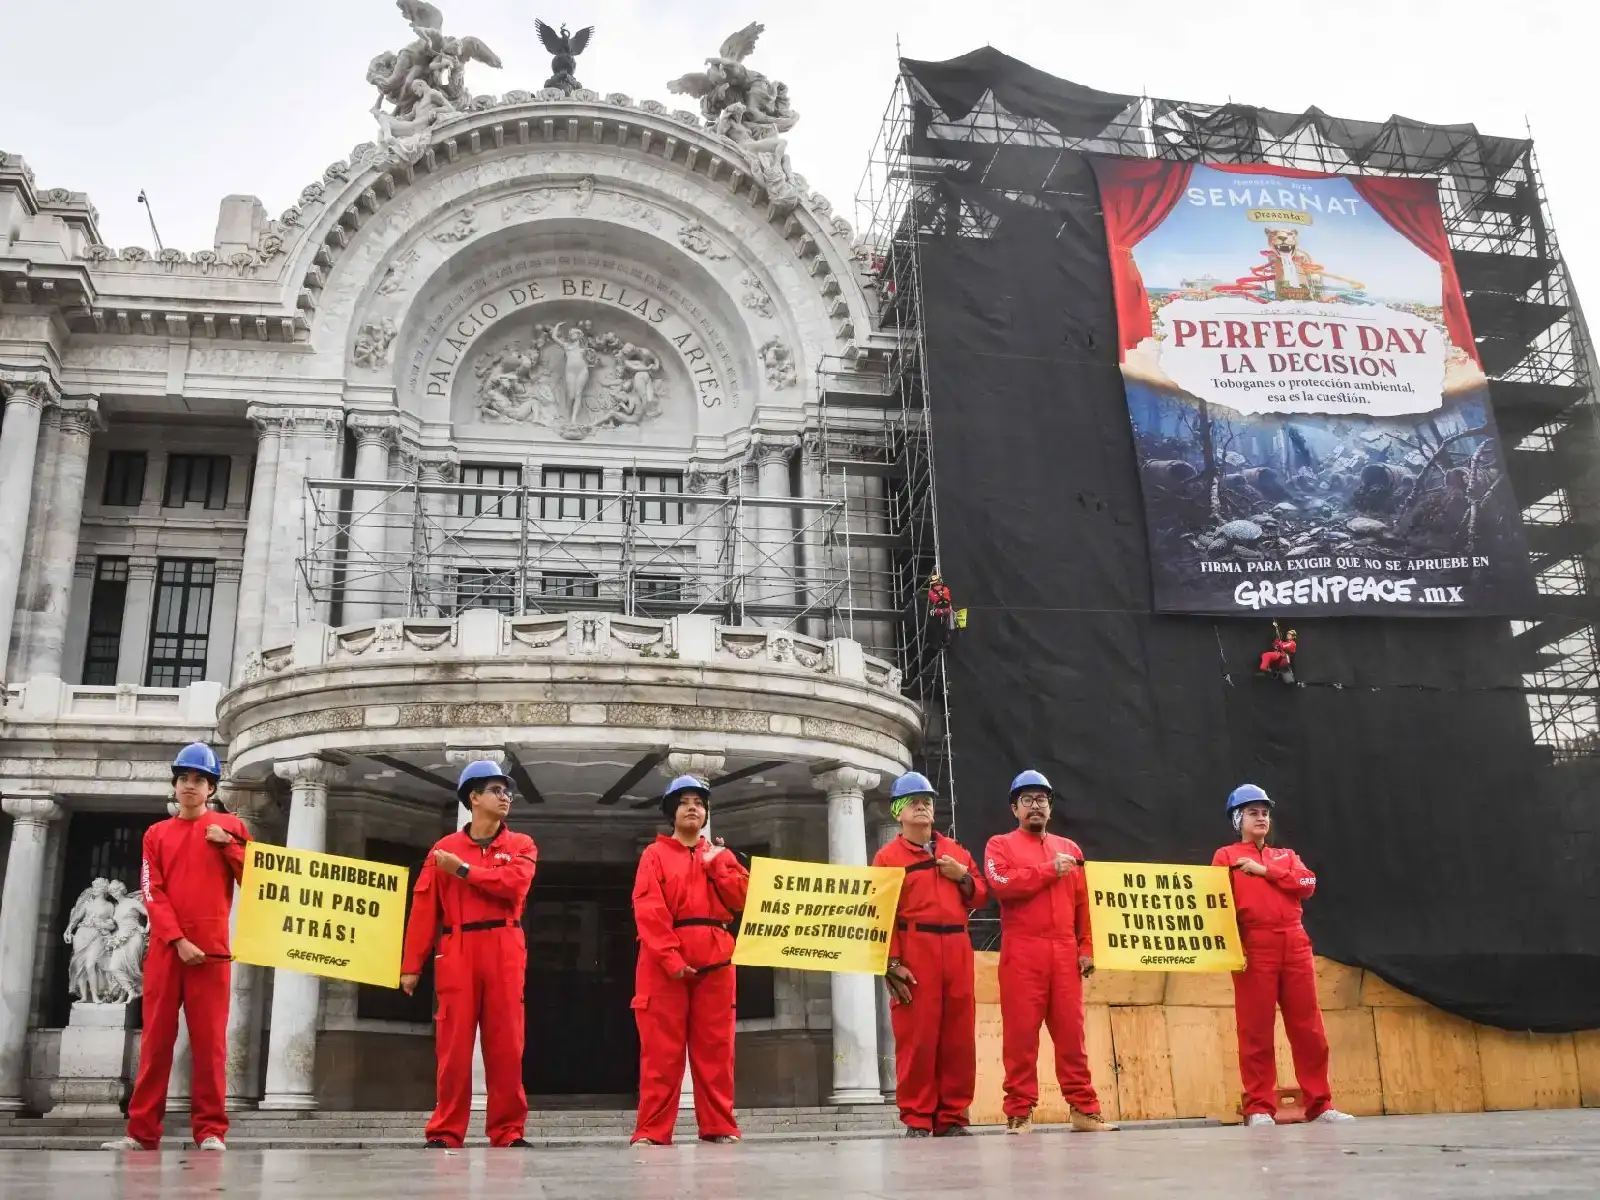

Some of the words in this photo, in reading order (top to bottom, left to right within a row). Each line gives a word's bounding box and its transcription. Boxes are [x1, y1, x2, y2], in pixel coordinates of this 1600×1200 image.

[1187, 186, 1359, 216] SEMARNAT
[427, 302, 499, 397] PALACIO
[509, 281, 546, 306] DE
[562, 278, 668, 324] BELLAS
[672, 331, 721, 410] ARTES
[1171, 318, 1348, 350] PERFECT
[1355, 324, 1428, 354] DAY
[1219, 353, 1258, 374] LA
[1267, 351, 1398, 378] DECISIÓN
[1210, 377, 1276, 394] Toboganes
[1278, 379, 1286, 388] o
[1288, 376, 1351, 391] protección
[1353, 379, 1416, 394] ambiental,
[1267, 393, 1287, 403] esa
[1289, 393, 1301, 402] es
[1302, 390, 1314, 402] la
[1316, 391, 1371, 405] cuestión.
[1200, 561, 1242, 574] FIRMA
[1246, 559, 1282, 573] PARA
[1287, 556, 1332, 570] EXIGIR
[1336, 555, 1361, 570] QUE
[1364, 558, 1382, 570] NO
[1385, 559, 1401, 572] SE
[1406, 556, 1469, 571] APRUEBE
[1472, 555, 1490, 568] EN
[253, 850, 302, 876] ROYAL
[308, 860, 398, 893] CARIBBEAN
[1123, 873, 1147, 889] NO
[1156, 871, 1193, 890] MÁS
[773, 874, 877, 895] SEMARNAT:
[257, 882, 290, 903] ¡DA
[299, 888, 324, 909] UN
[331, 893, 381, 918] PASO
[760, 898, 790, 915] MÁS
[795, 901, 880, 920] PROTECCIÓN,
[1094, 890, 1197, 910] PROYECTOS
[1206, 893, 1228, 909] DE
[282, 914, 356, 945] ATRÁS!
[1121, 912, 1205, 932] TURISMO
[743, 921, 789, 938] MENOS
[794, 922, 888, 944] DESTRUCCIÓN
[1108, 933, 1226, 951] DEPREDADOR
[286, 948, 351, 968] GREENPEACE
[781, 946, 842, 960] GREENPEACE
[1140, 955, 1198, 965] GREENPEACE
